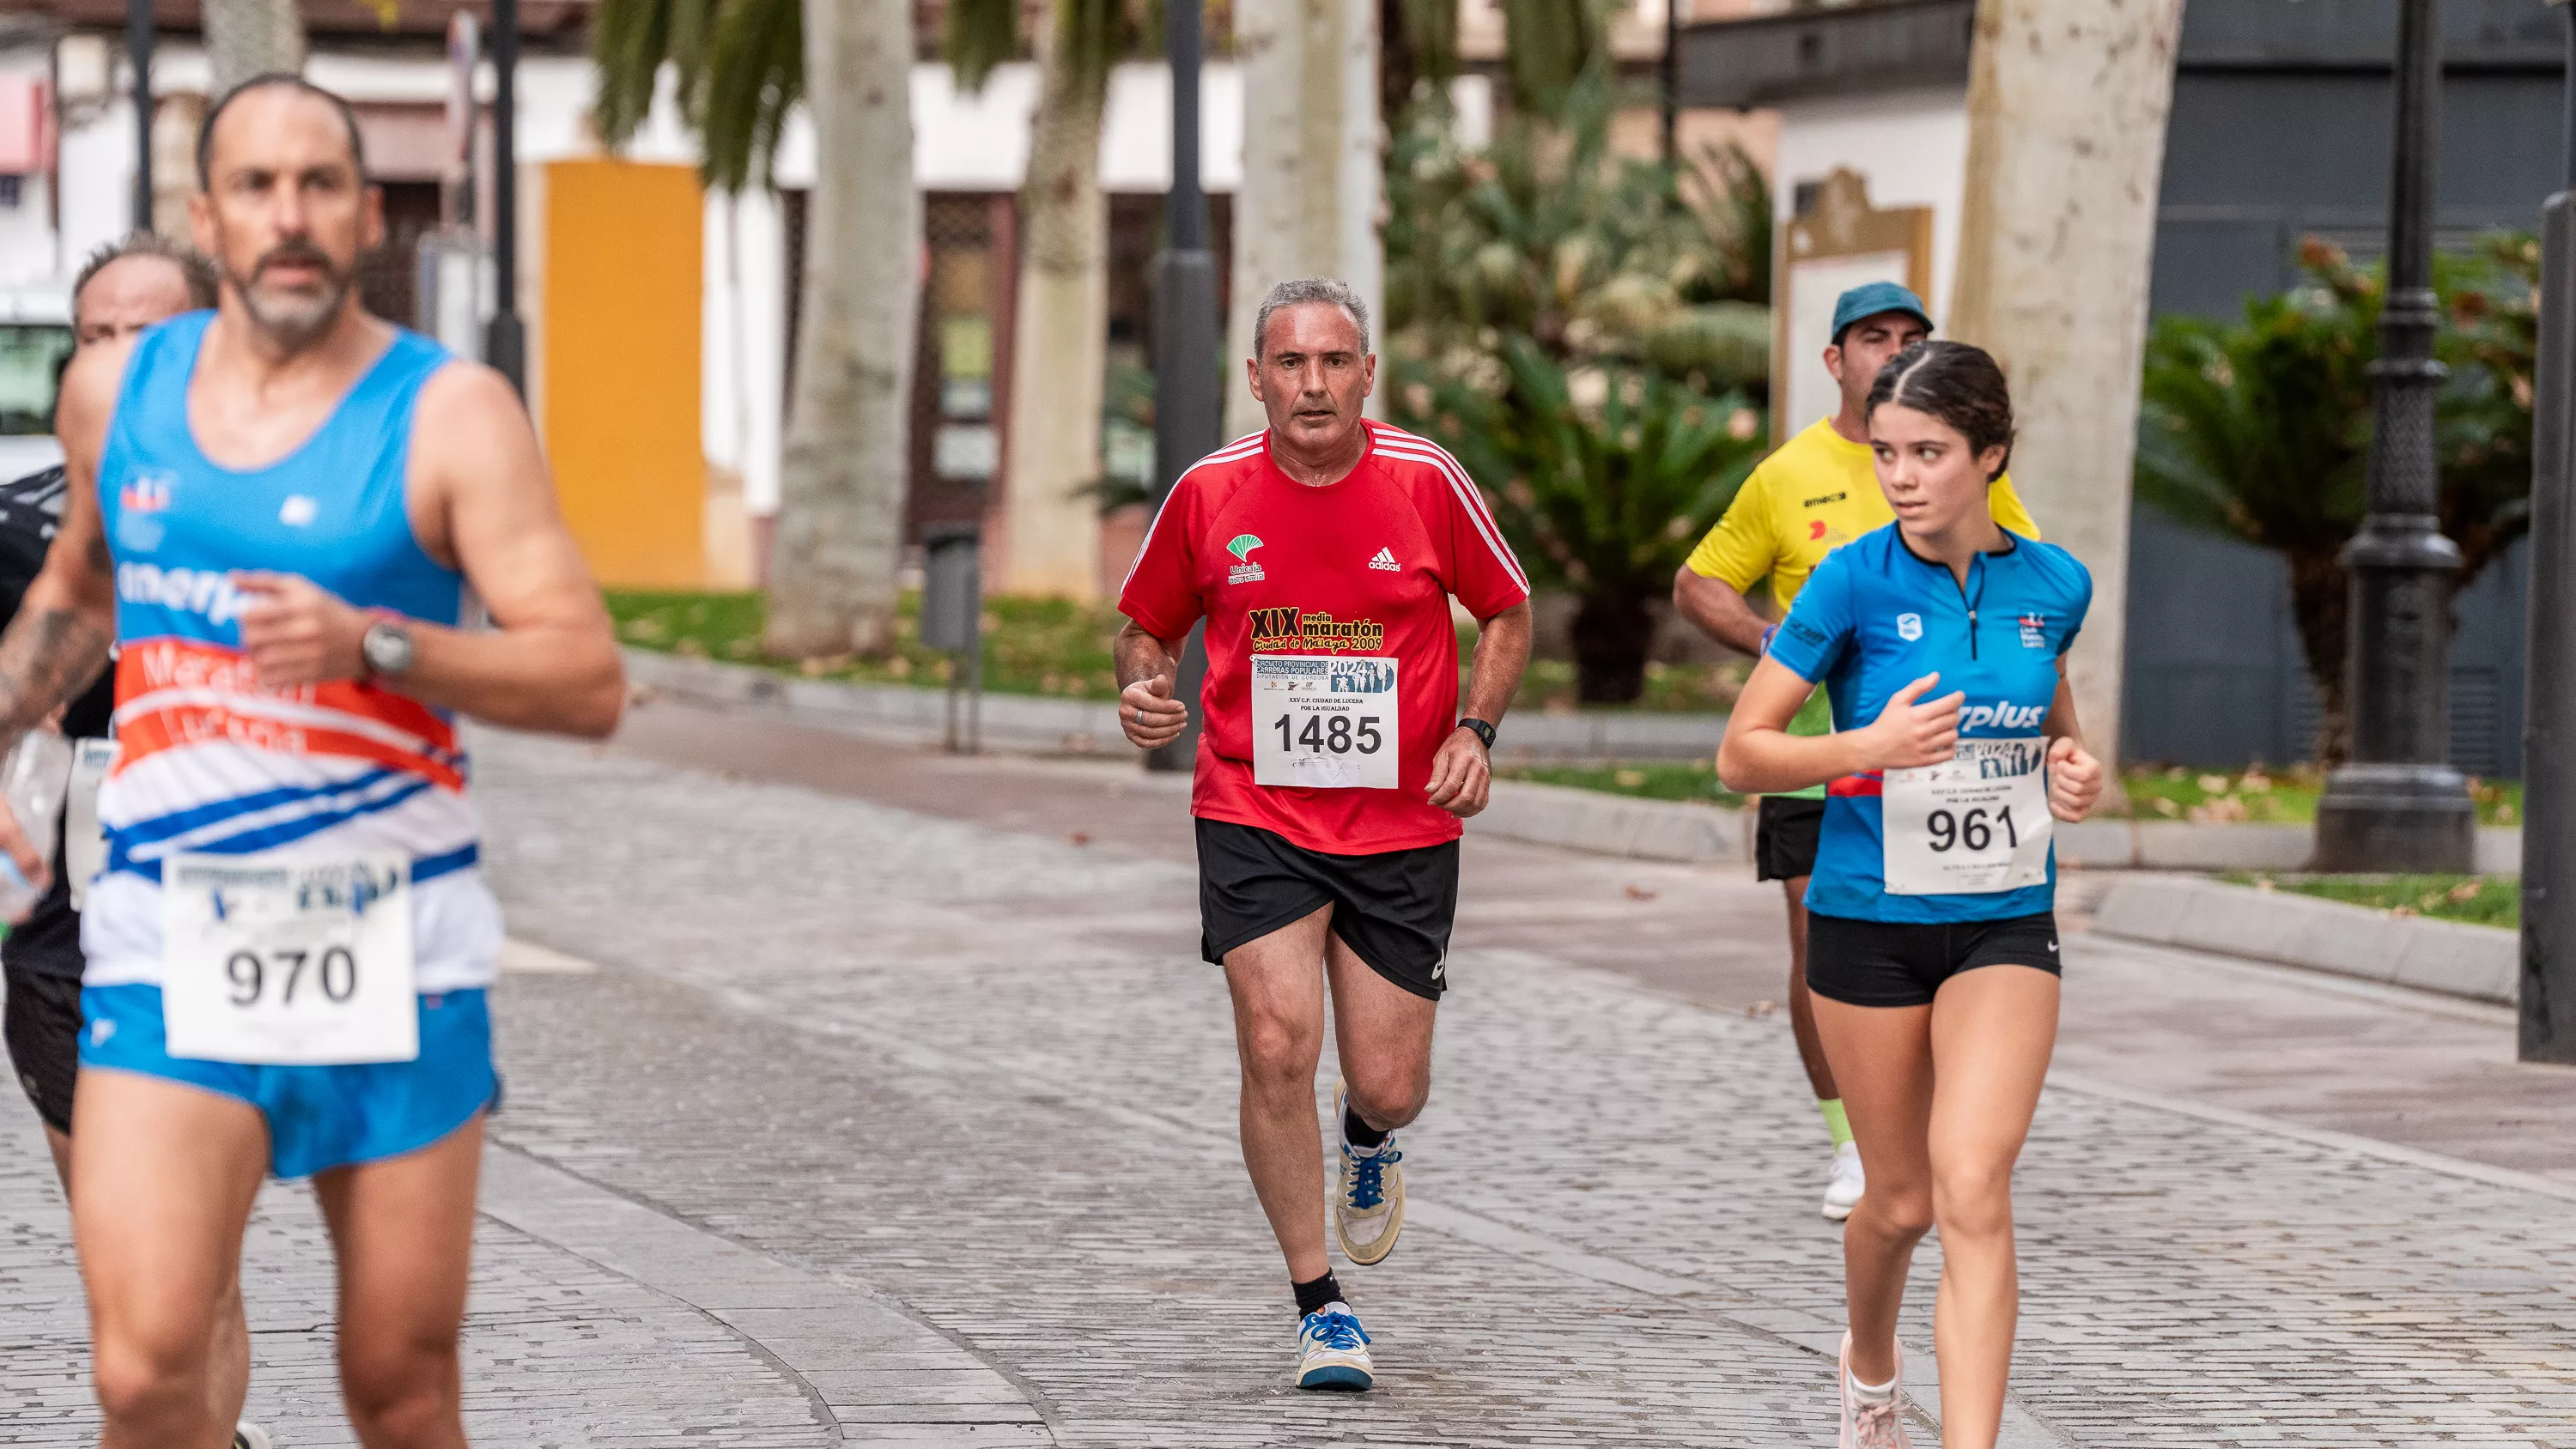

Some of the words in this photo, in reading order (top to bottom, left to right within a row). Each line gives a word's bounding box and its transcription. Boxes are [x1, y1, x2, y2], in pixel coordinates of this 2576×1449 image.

[1230, 562, 1261, 574] Unicaja
[1369, 561, 1400, 572] adidas
[1249, 607, 1300, 639] XIX
[1303, 612, 1332, 622] media
[1302, 619, 1383, 638] maratón
[1254, 640, 1286, 651] Ciudad
[1303, 638, 1349, 654] Málaga
[1351, 637, 1382, 650] 2009
[1329, 660, 1368, 676] 2024
[1958, 700, 2045, 732] rplus
[1275, 714, 1382, 754] 1485
[1927, 805, 2017, 852] 961
[228, 947, 355, 1007] 970
